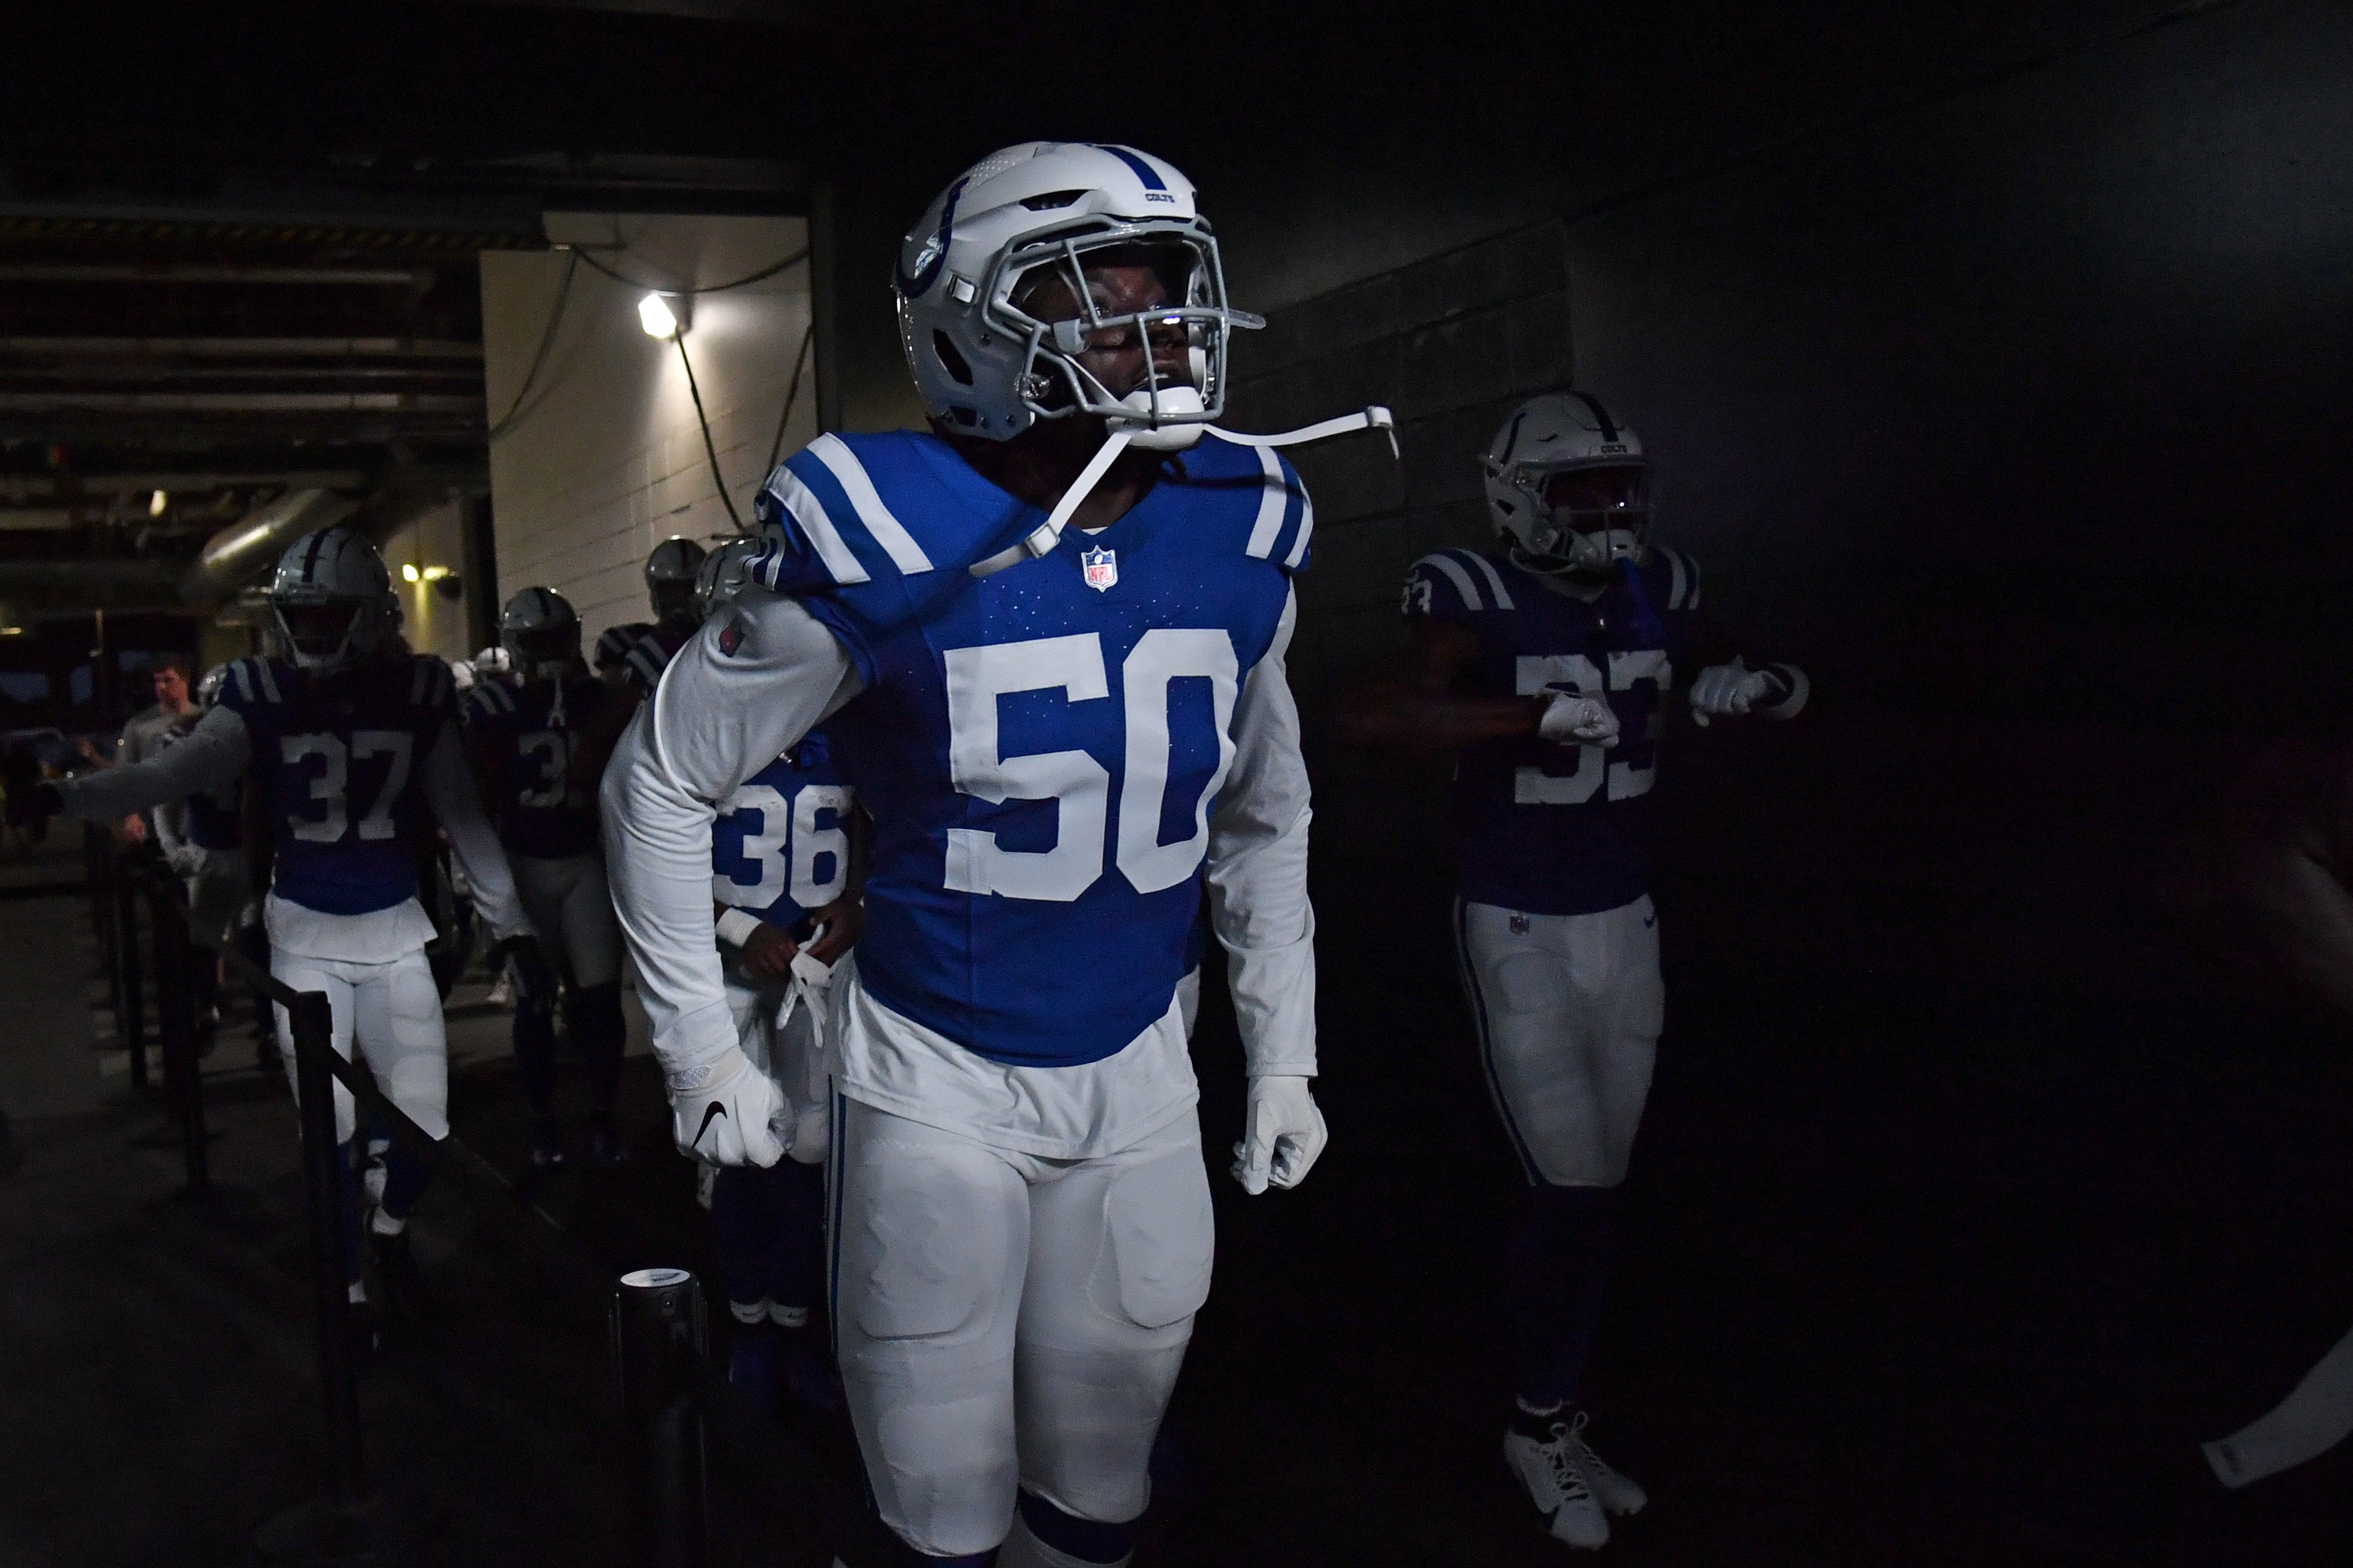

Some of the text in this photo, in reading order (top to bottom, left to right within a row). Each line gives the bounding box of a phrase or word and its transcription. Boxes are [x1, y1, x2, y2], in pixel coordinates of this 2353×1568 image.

[280, 730, 414, 843] 37
[943, 628, 1239, 902] 50
[713, 784, 856, 910] 36
